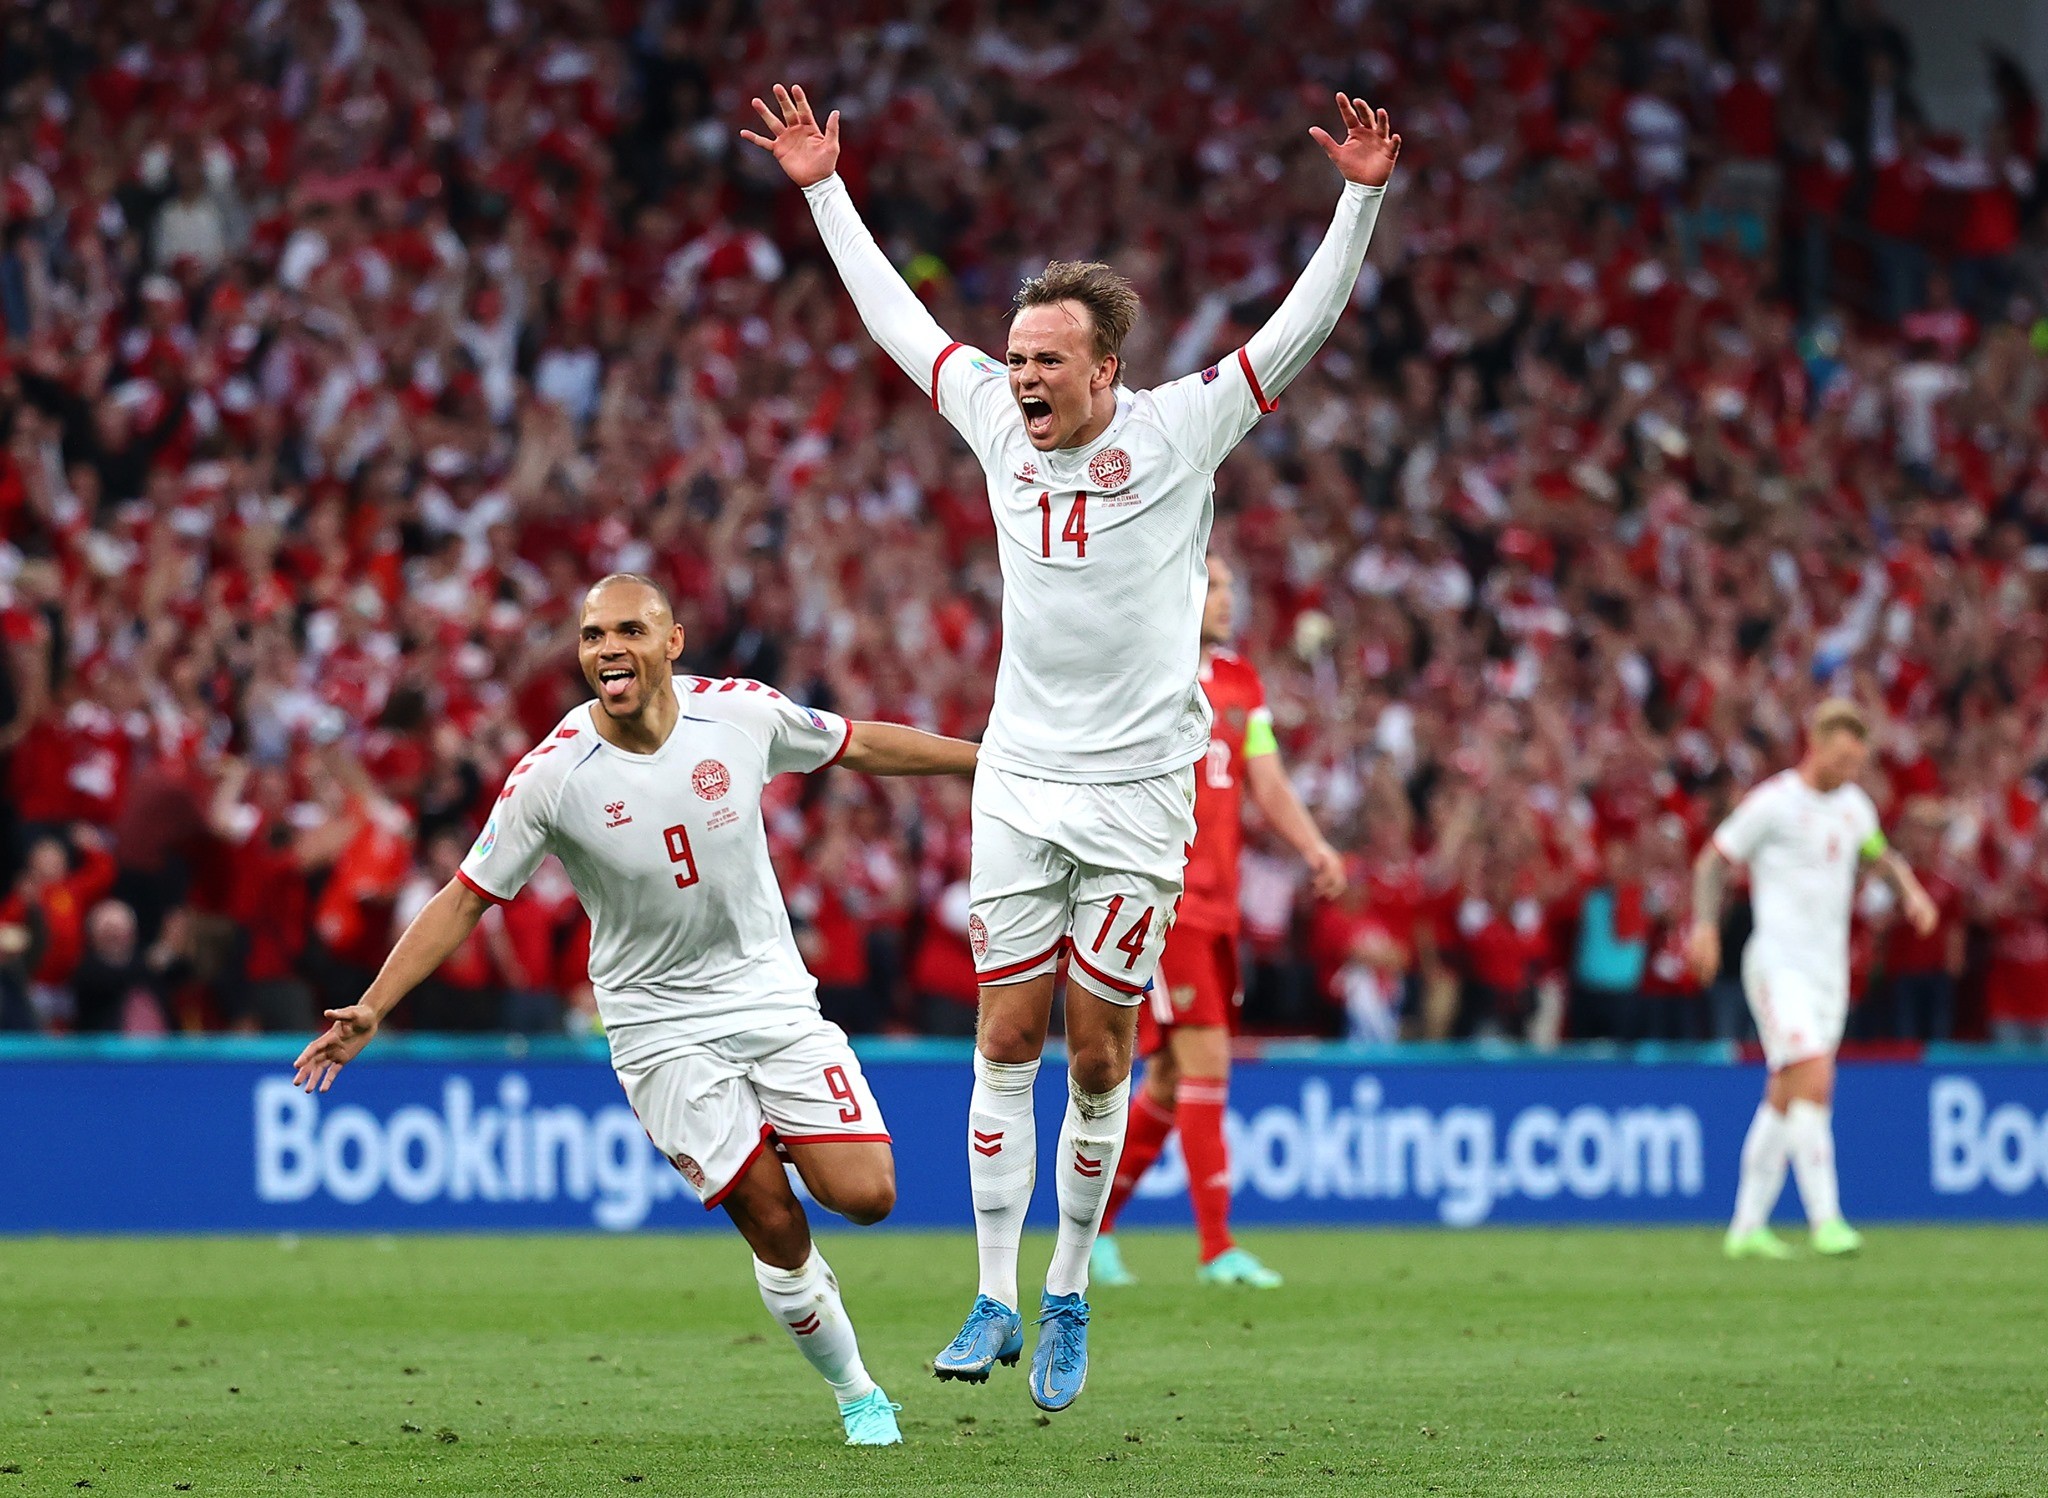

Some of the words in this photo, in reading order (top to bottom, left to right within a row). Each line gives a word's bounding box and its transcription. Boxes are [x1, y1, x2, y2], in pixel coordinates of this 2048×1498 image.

[1096, 458, 1124, 478] DBU
[1037, 490, 1089, 558] 14
[698, 770, 724, 790] DBU
[605, 815, 633, 828] hummel
[663, 824, 699, 889] 9
[1091, 894, 1154, 970] 14
[823, 1065, 862, 1123] 9
[253, 1074, 696, 1232] Booking.
[1135, 1076, 1702, 1228] oking.com
[1928, 1075, 2048, 1196] Bo
